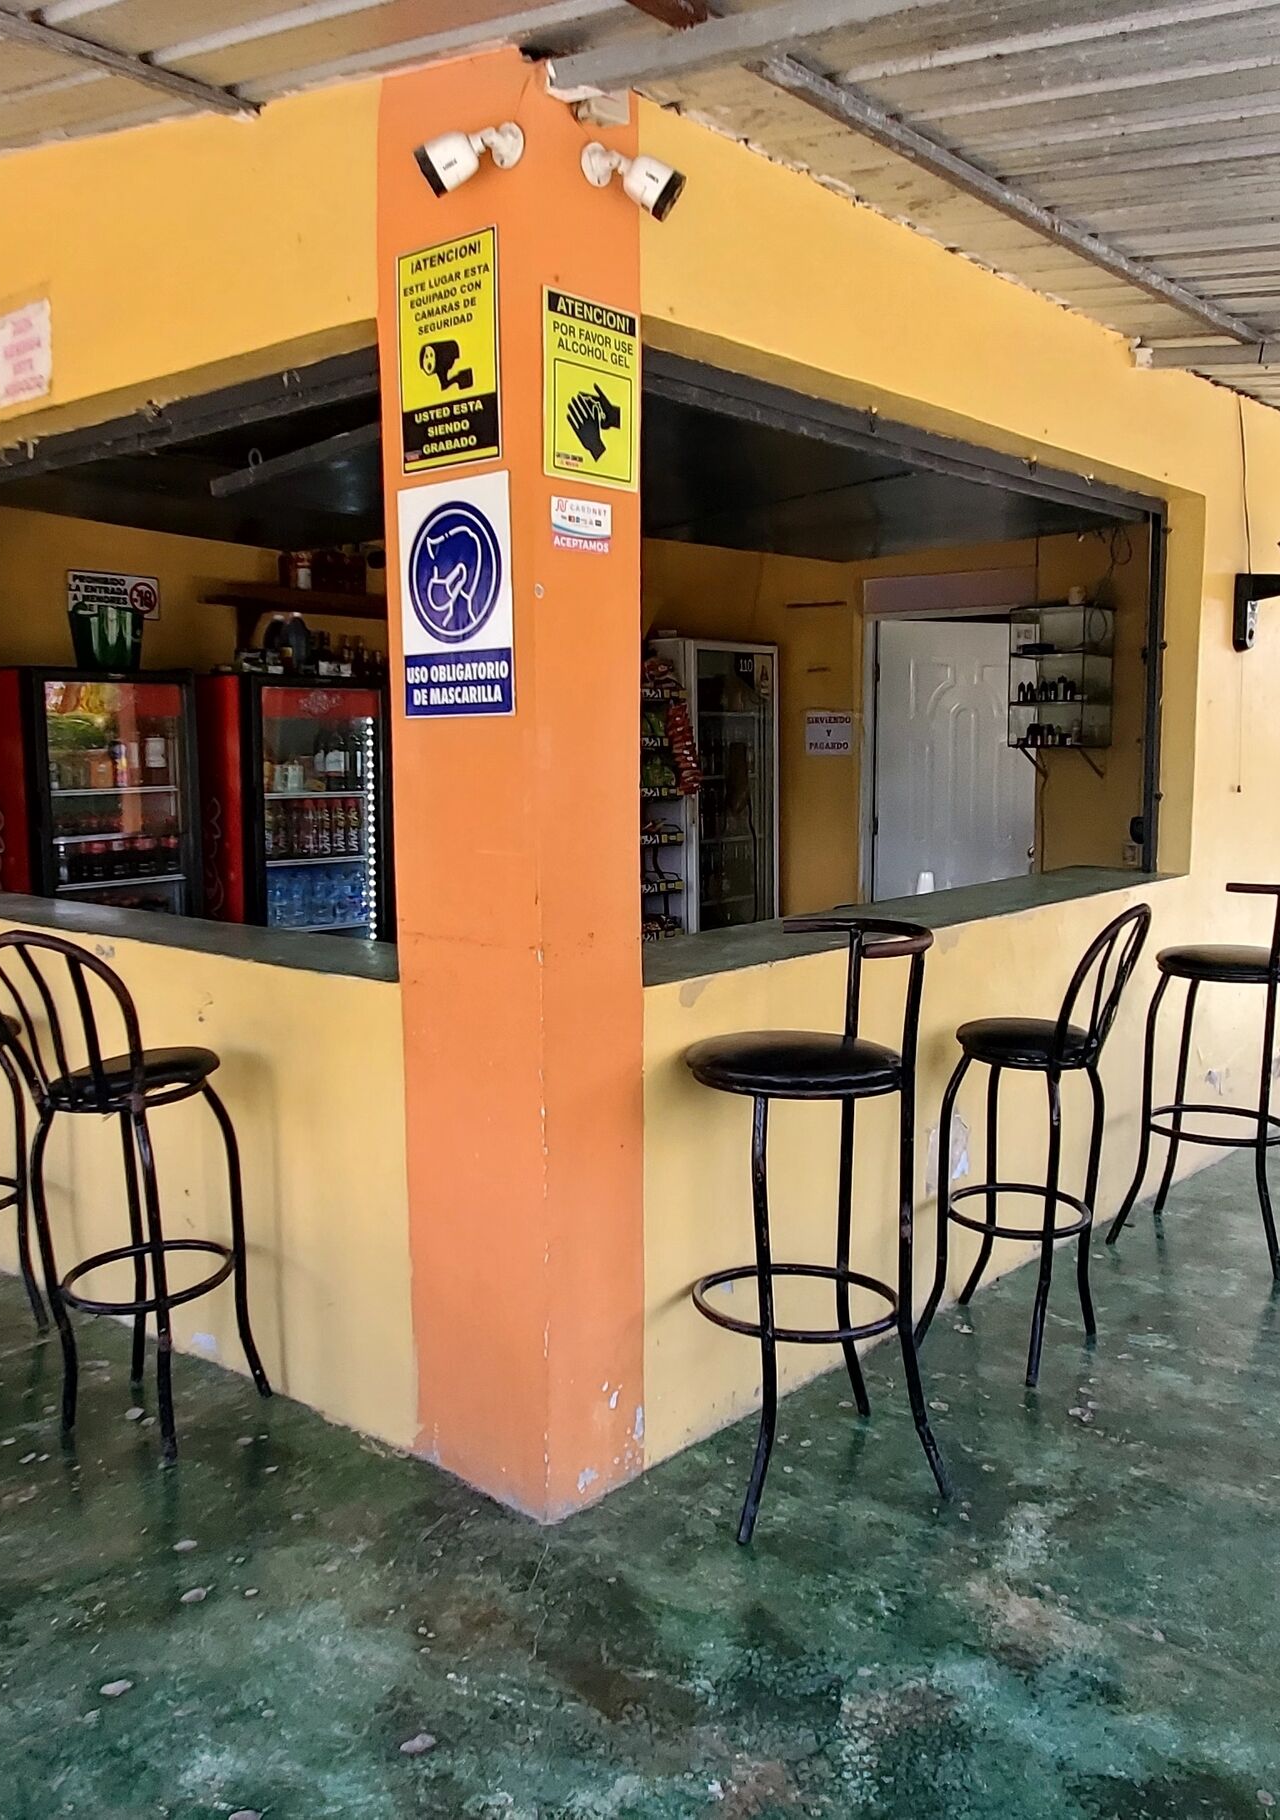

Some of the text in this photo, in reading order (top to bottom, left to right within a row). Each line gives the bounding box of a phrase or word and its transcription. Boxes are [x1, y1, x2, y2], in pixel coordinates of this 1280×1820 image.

[411, 240, 481, 275] ¡ATENCION!
[403, 262, 490, 297] ESTE LUGAR ESTA
[410, 280, 482, 309] EQUIPADO CON
[414, 297, 477, 322] CAMARAS DE
[556, 296, 630, 334] ATENCION!
[418, 312, 473, 335] SEGURIDAD
[553, 320, 634, 356] POR FAVOR USE
[557, 336, 630, 369] ALCOHOL GEL
[414, 399, 483, 424] USTED ESTA
[427, 419, 470, 437] SIENDO
[422, 435, 477, 455] GRABADO
[553, 535, 609, 553] ACEPTAMOS
[68, 584, 129, 596] LA ENTRADA
[72, 593, 79, 601] A
[406, 660, 509, 684] USO OBLIGATORIO
[739, 658, 753, 672] 110
[413, 684, 503, 706] DE MASCARILLA
[826, 729, 832, 737] Y
[809, 742, 849, 750] PAGANDO
